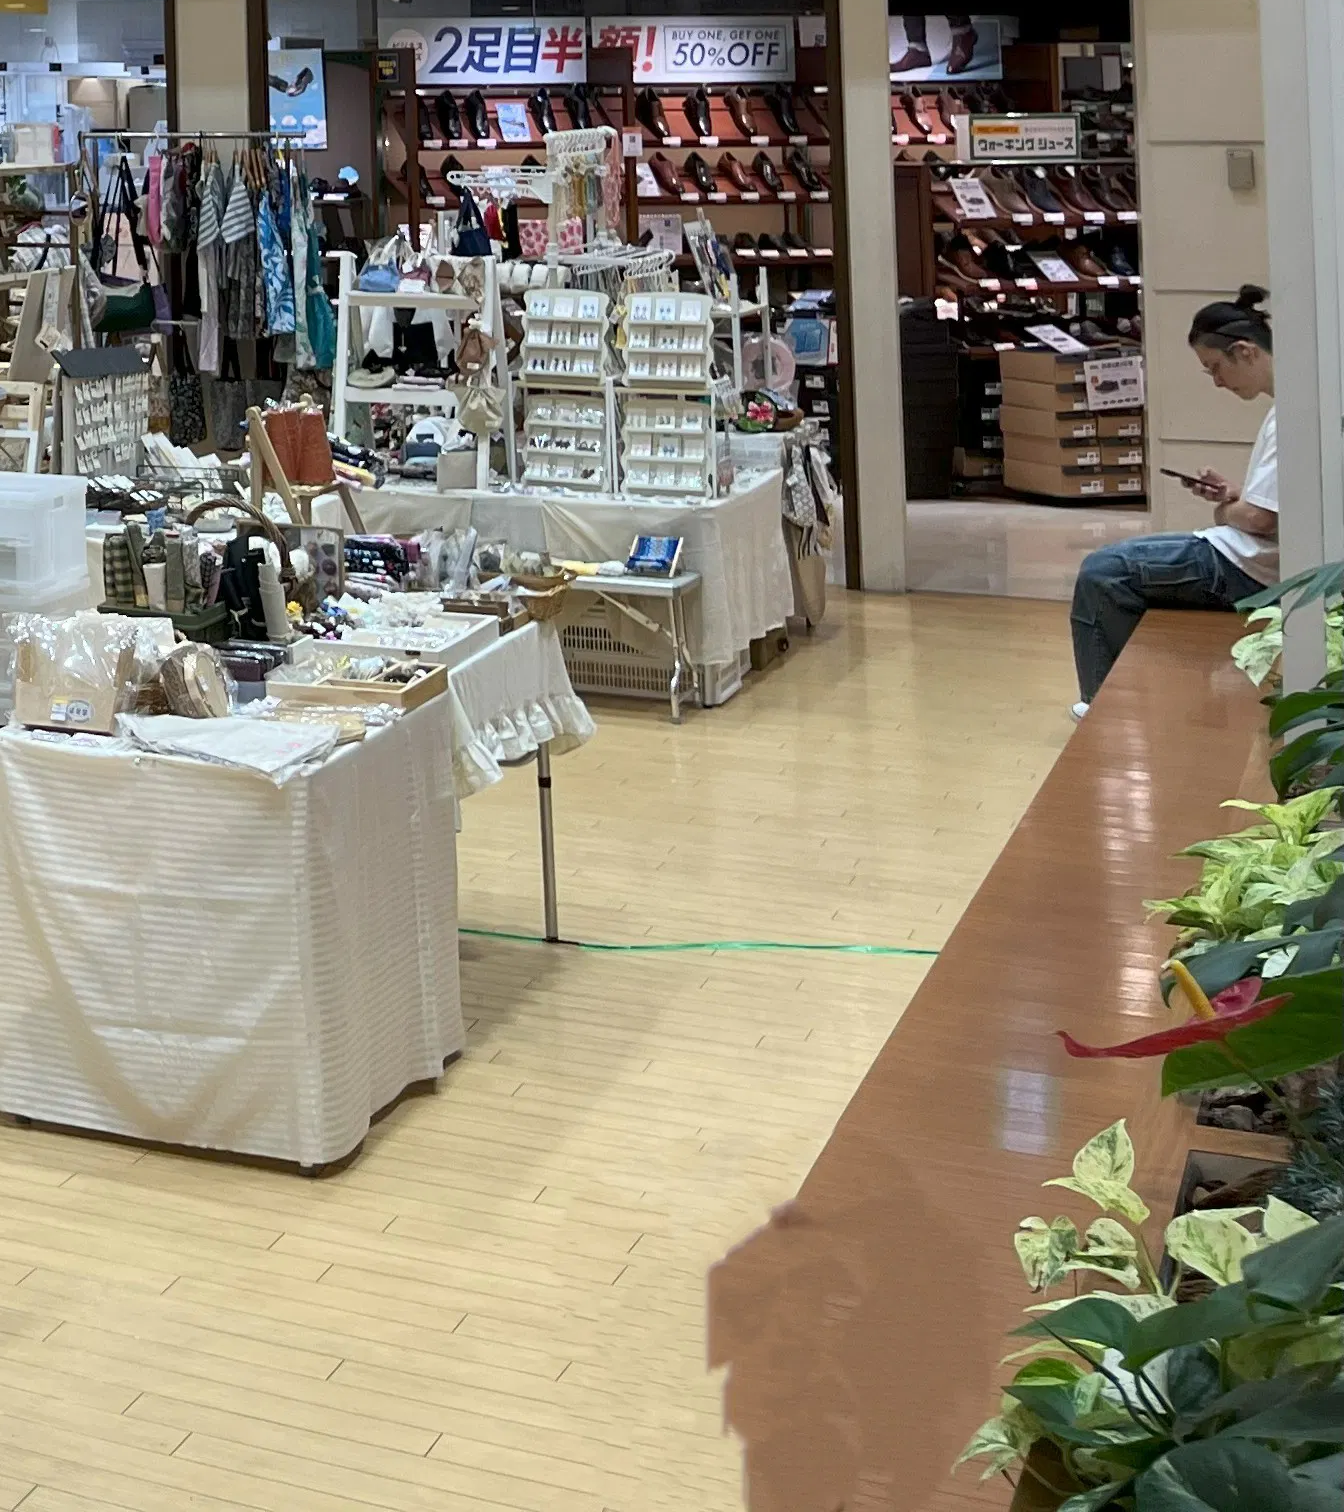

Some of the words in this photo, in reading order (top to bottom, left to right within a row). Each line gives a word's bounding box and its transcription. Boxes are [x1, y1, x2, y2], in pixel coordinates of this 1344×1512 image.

[671, 30, 694, 41] BUY
[729, 30, 751, 41] GET
[753, 30, 780, 41] ONE
[672, 42, 780, 68] 50%OFF
